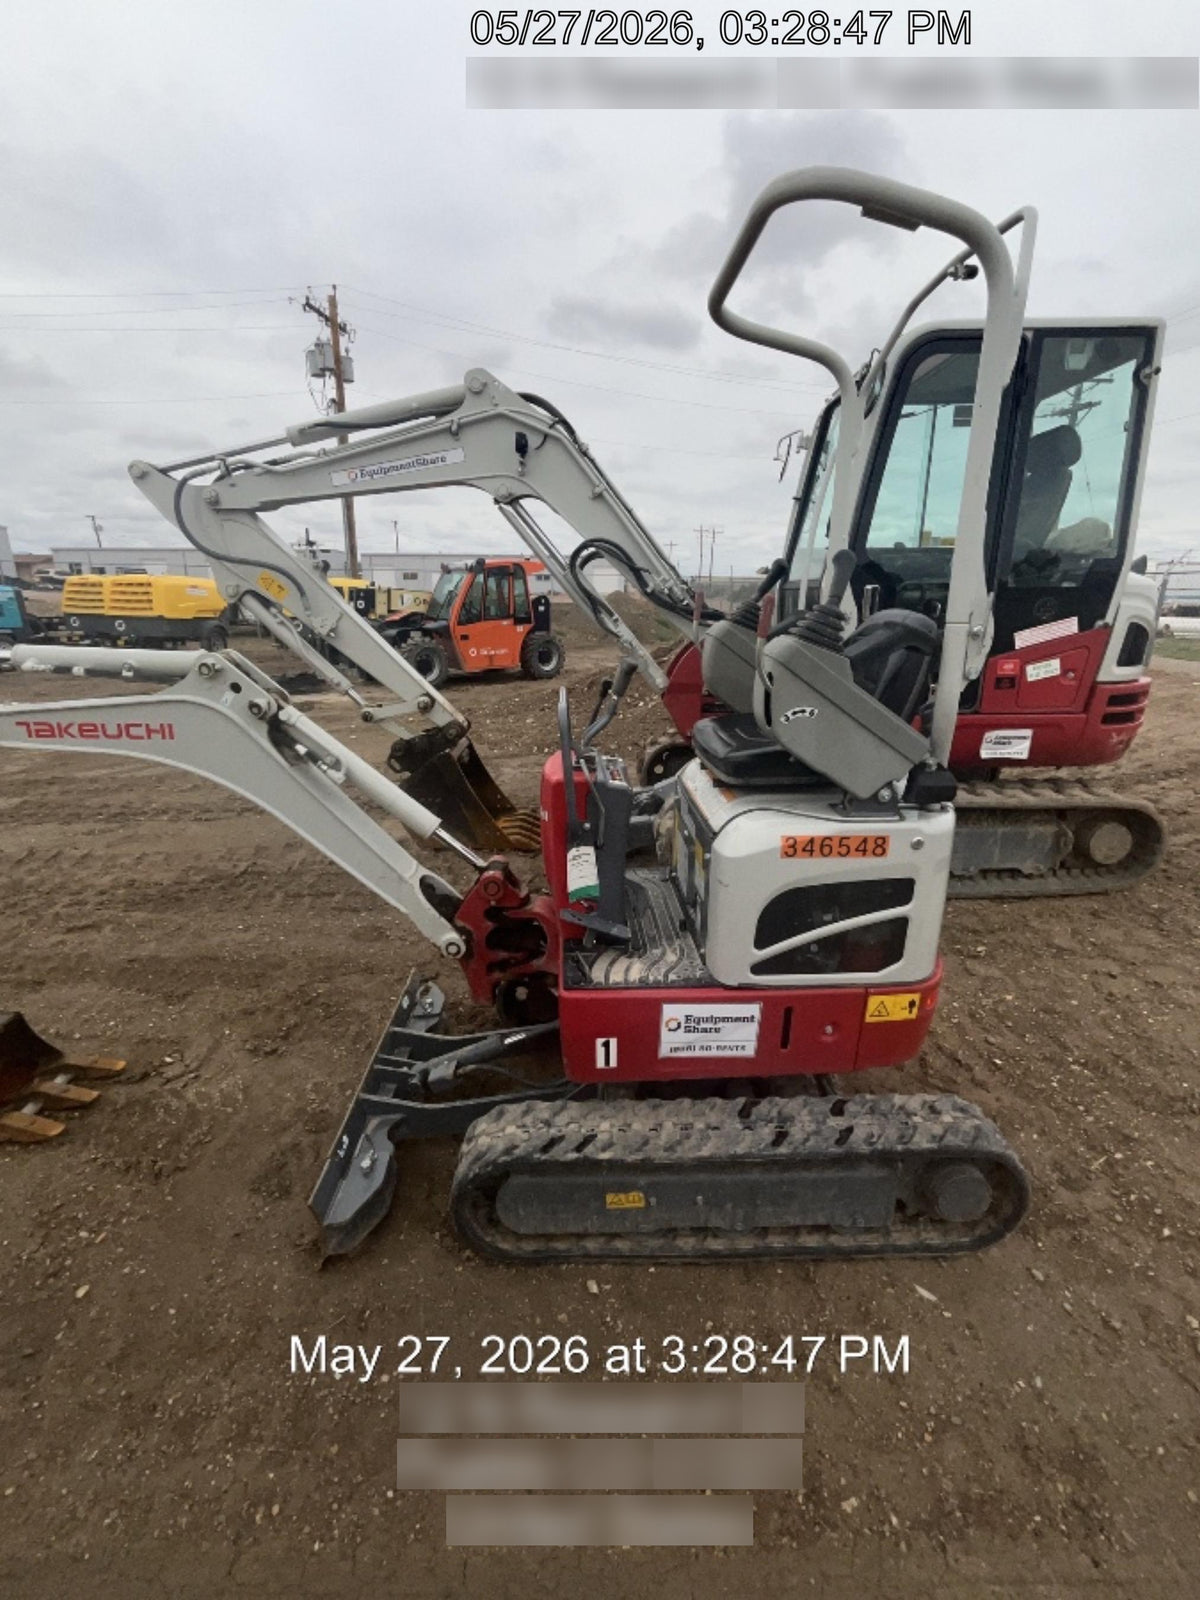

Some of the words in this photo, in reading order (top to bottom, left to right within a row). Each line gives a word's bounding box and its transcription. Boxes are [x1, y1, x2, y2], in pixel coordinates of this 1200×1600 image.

[783, 836, 887, 858] 346548
[683, 1014, 756, 1026] Equipment
[683, 1025, 721, 1034] Share
[601, 1039, 610, 1067] 1
